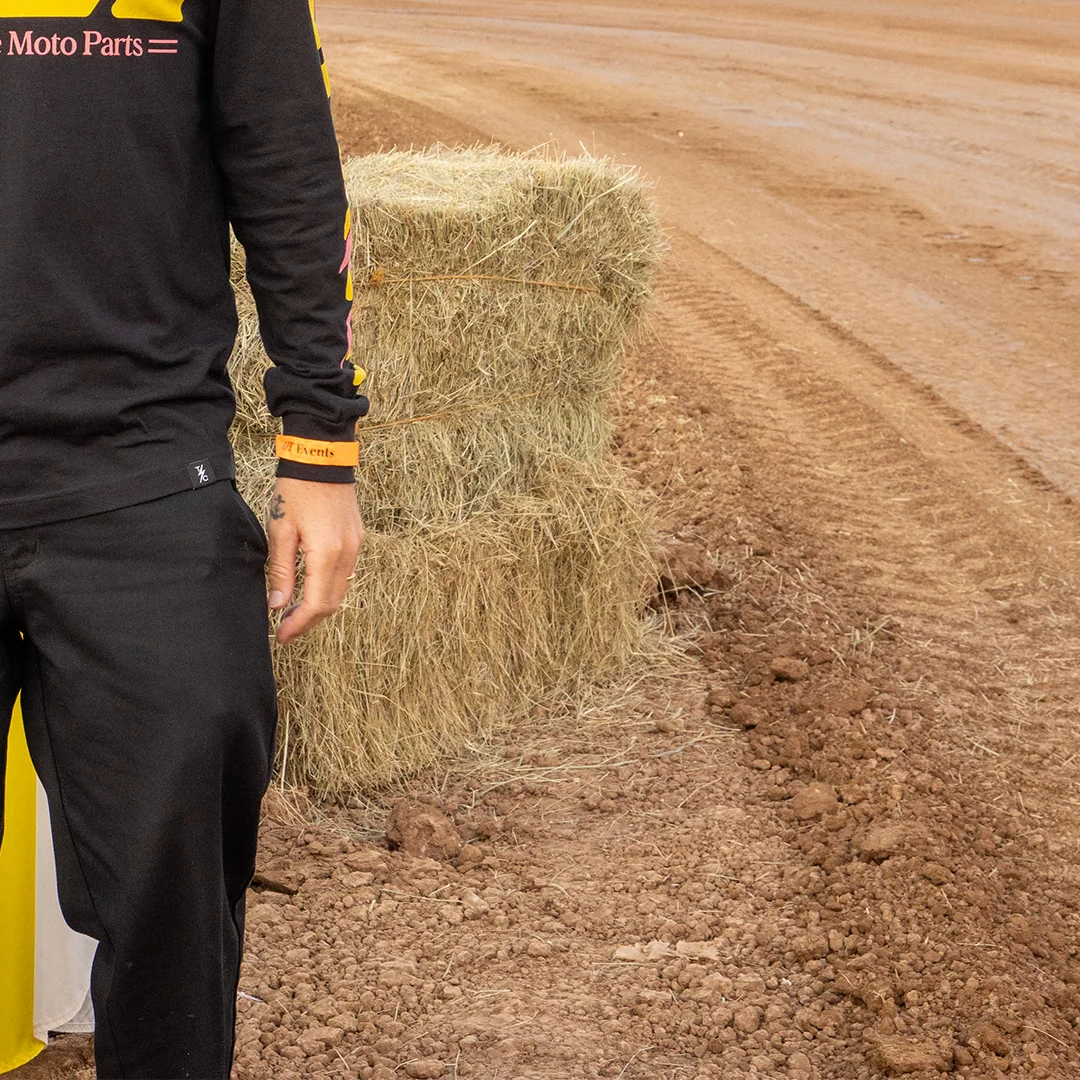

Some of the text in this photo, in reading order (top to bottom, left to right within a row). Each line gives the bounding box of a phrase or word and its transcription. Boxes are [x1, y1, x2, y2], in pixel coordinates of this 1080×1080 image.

[9, 30, 77, 57] Moto
[83, 30, 143, 57] Parts
[296, 443, 336, 458] Events
